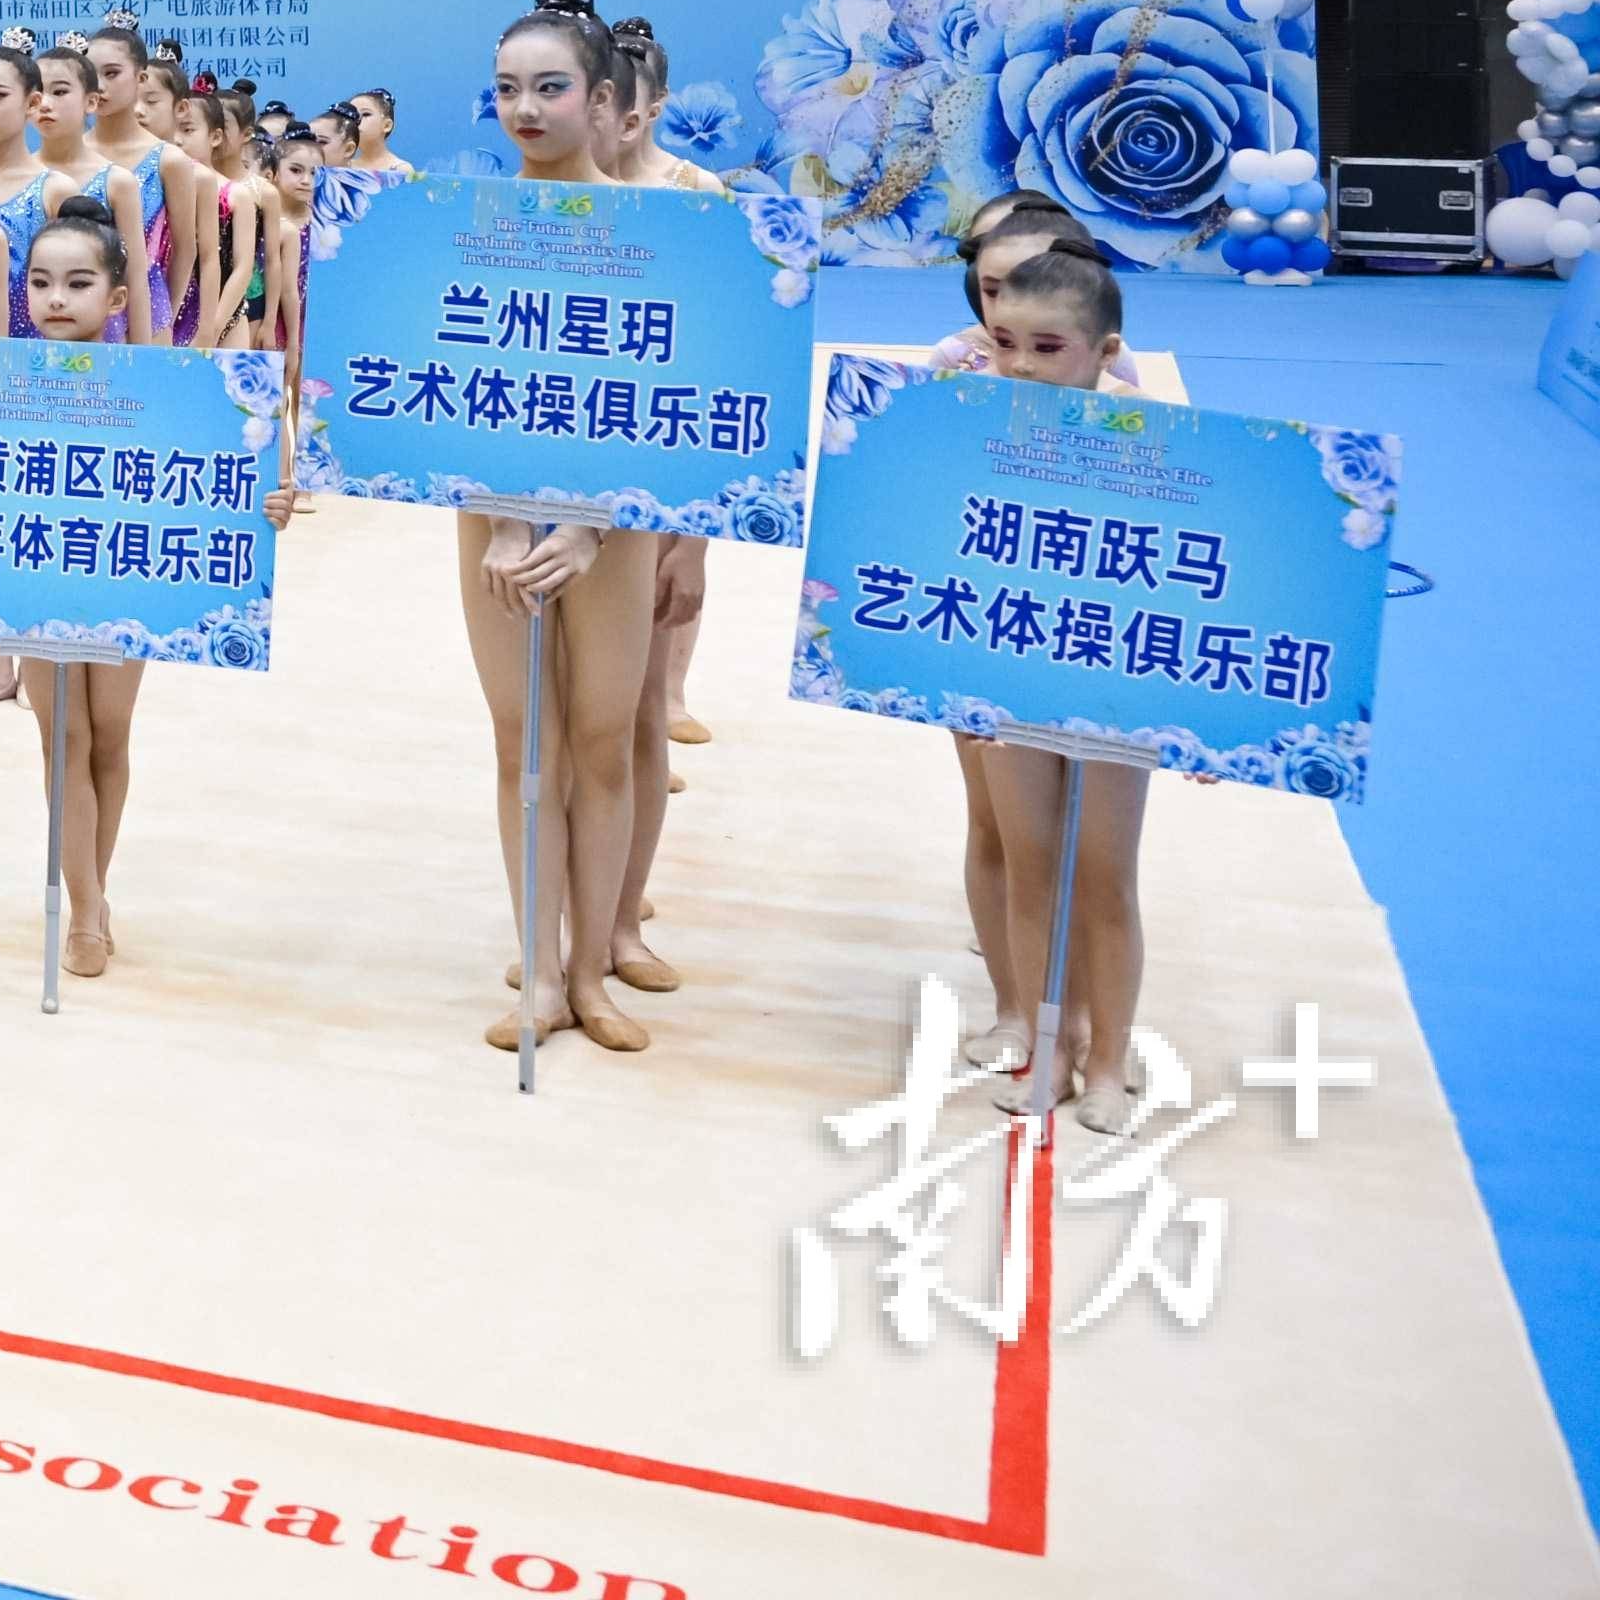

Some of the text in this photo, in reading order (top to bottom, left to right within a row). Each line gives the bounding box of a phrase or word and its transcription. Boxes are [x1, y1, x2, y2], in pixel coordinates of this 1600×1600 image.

[454, 232, 656, 262] Rhythmic Gymnastics Elite
[461, 251, 645, 279] Invitational Competition
[436, 283, 677, 367] 兰州星玥
[346, 354, 772, 458] 艺术体操俱乐部
[984, 437, 1214, 489] Rhythmic Gymnastics Elite
[991, 457, 1201, 507] Invitational Competition
[957, 494, 1231, 602] 湖南跃马
[852, 560, 1335, 709] 艺术体操俱乐部
